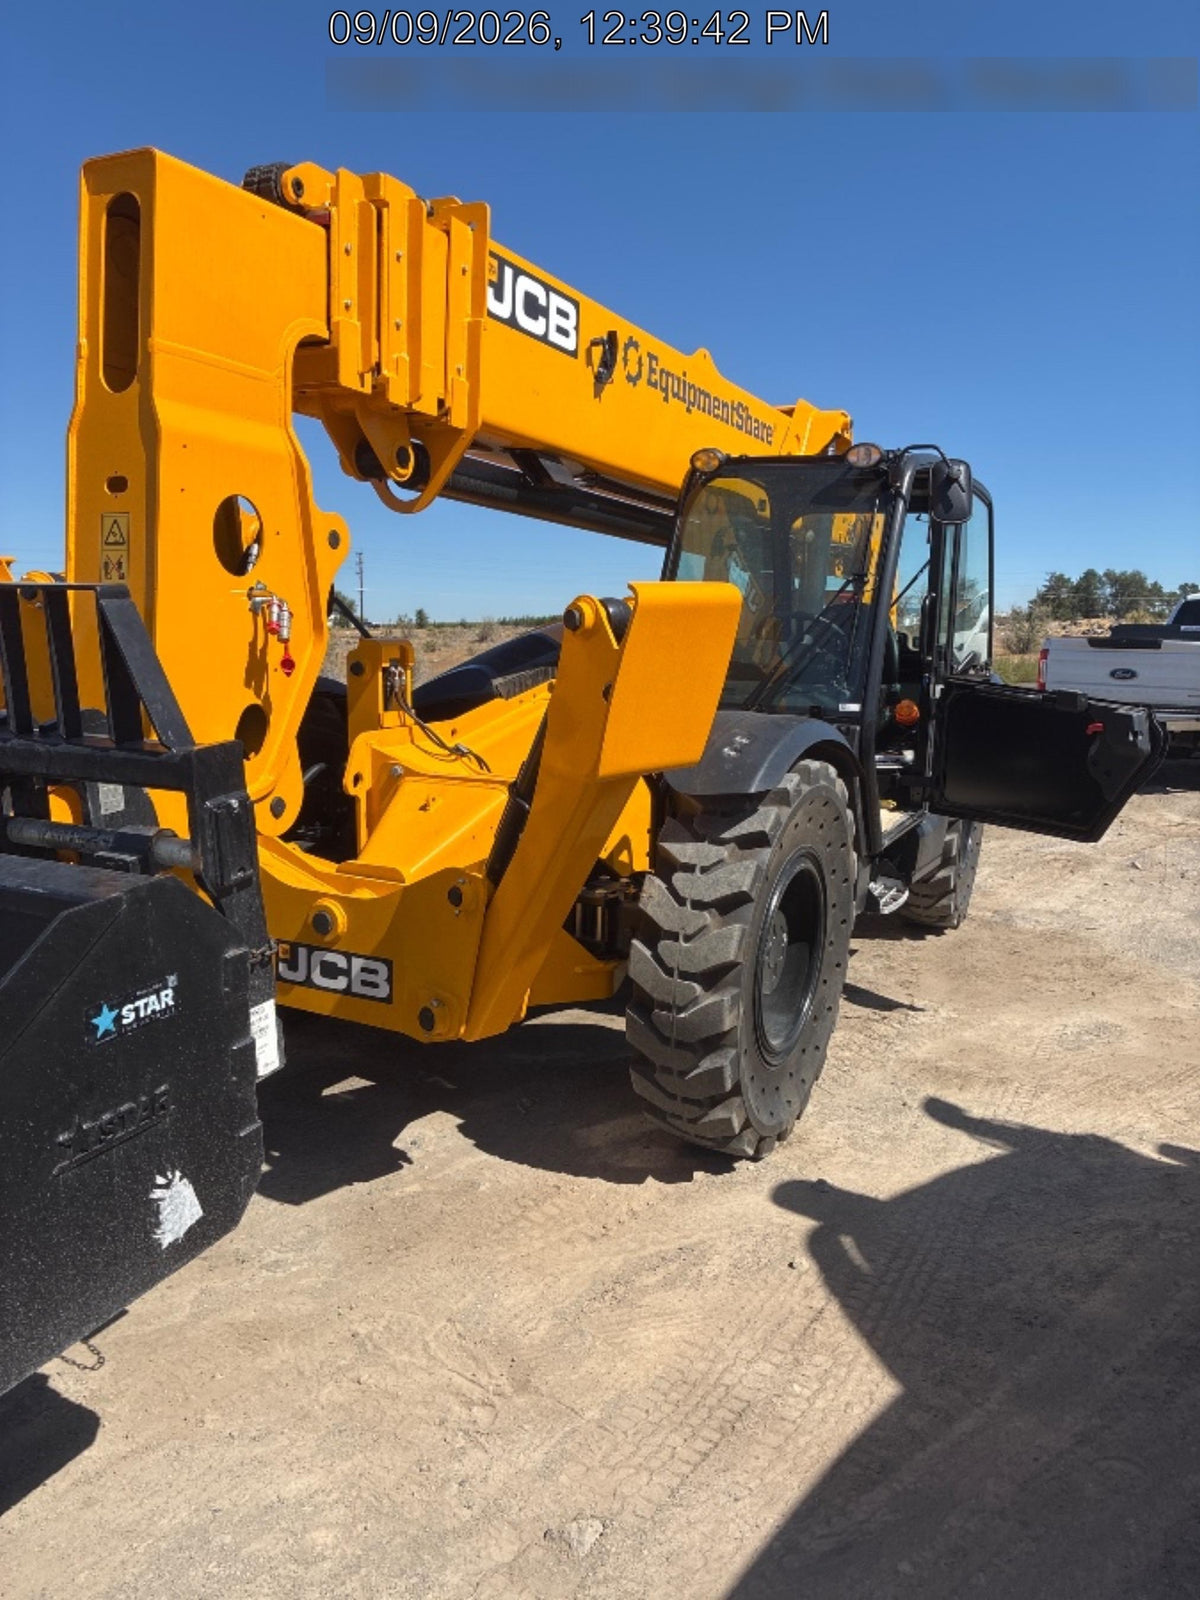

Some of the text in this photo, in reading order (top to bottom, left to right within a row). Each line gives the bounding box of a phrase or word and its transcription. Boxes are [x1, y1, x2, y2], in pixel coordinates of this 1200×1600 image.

[486, 264, 577, 351] JCB
[646, 351, 773, 447] EquipmentShare
[121, 987, 175, 1025] STAR
[278, 946, 390, 998] JCB
